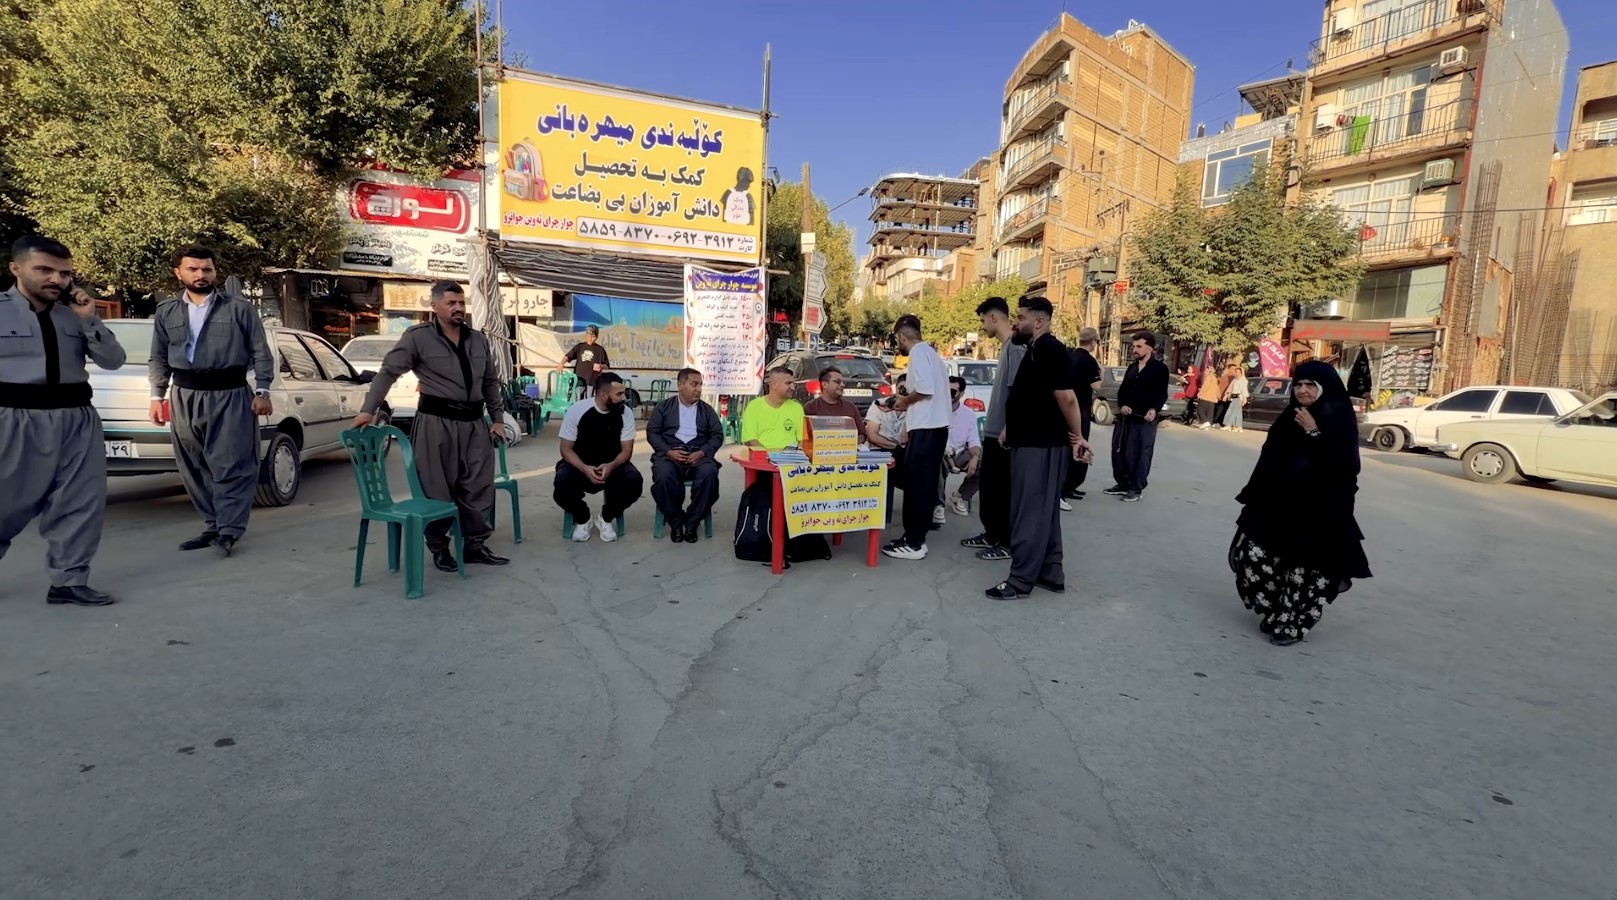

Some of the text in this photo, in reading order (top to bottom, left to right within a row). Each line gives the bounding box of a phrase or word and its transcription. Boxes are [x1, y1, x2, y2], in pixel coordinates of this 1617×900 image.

[574, 151, 705, 187] کمک به تحصیل
[552, 182, 720, 220] دانش آموزان بی بضاعت
[112, 445, 128, 456] ۲۹
